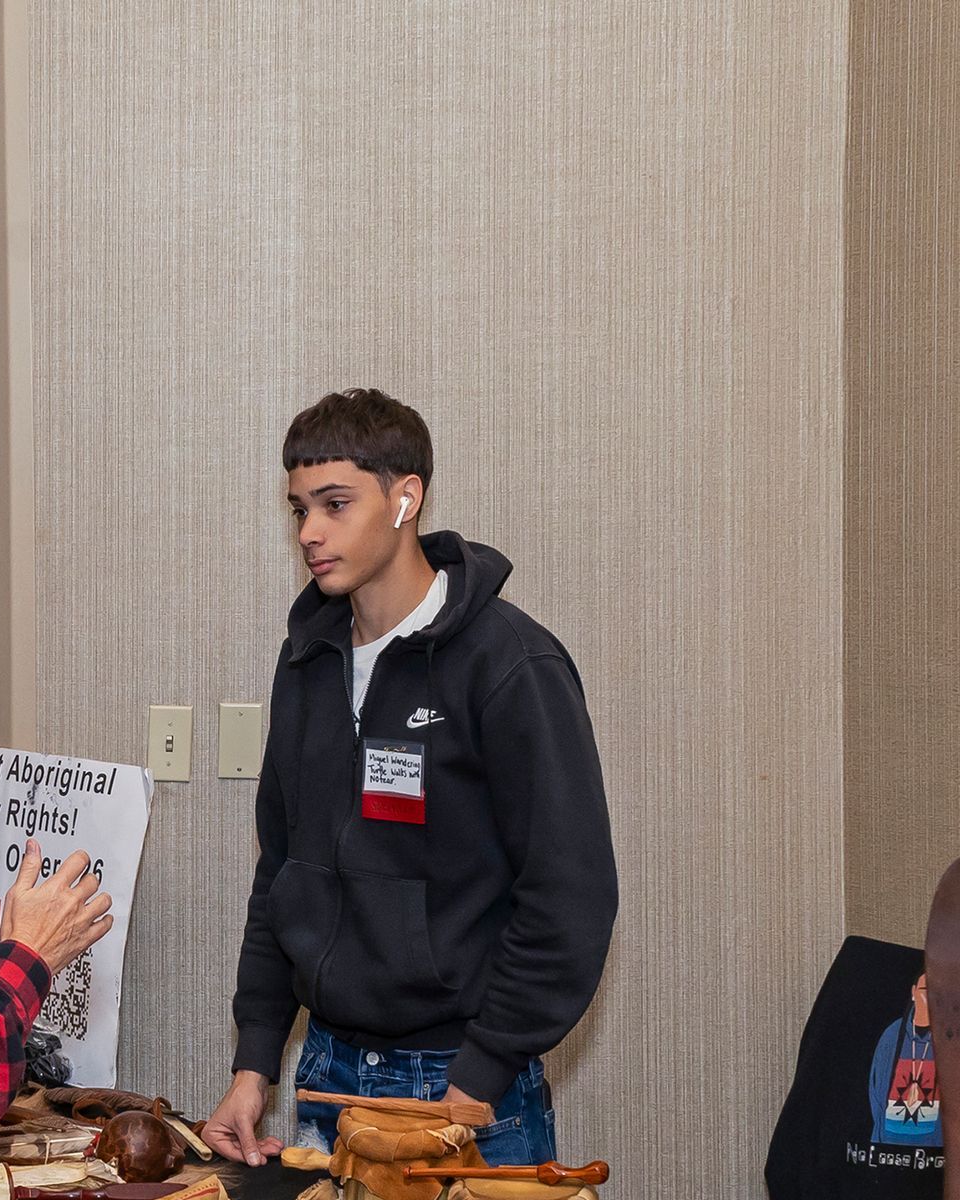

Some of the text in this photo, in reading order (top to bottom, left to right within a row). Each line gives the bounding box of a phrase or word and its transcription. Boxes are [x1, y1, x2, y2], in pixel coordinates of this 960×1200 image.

[6, 754, 117, 796] Aboriginal
[6, 798, 78, 837] Rights!
[6, 844, 61, 880] Oer
[846, 1142, 866, 1164] No
[868, 1145, 911, 1168] Loose
